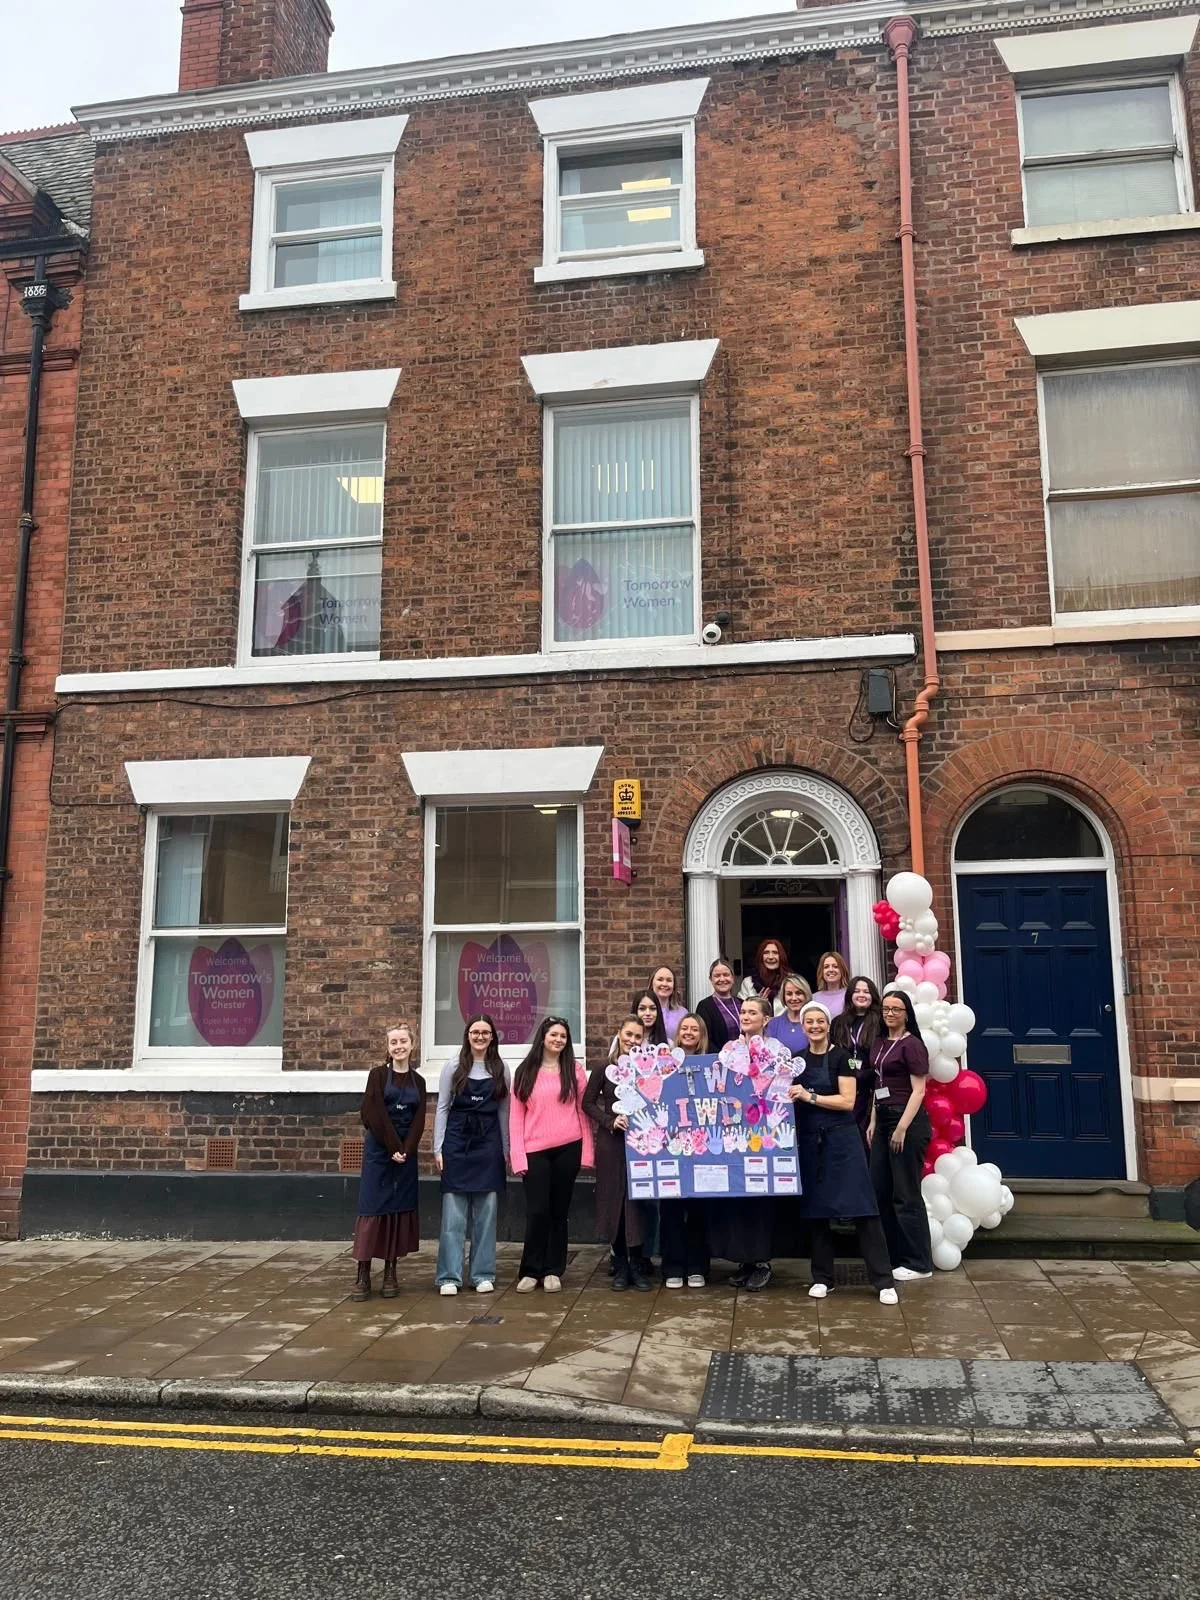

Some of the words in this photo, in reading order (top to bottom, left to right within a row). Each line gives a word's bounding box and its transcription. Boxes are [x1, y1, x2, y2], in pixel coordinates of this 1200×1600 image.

[624, 597, 676, 609] Women
[320, 613, 367, 625] Women
[1031, 932, 1039, 945] 7
[206, 957, 247, 966] Welcome
[477, 953, 521, 964] Welcome
[192, 970, 272, 985] Tomorrow's
[461, 968, 548, 983] Tomorrow's
[203, 986, 254, 999] Women
[473, 984, 529, 998] Women
[211, 1001, 246, 1009] Chester
[482, 999, 521, 1009] Chester
[675, 1096, 743, 1127] IWD
